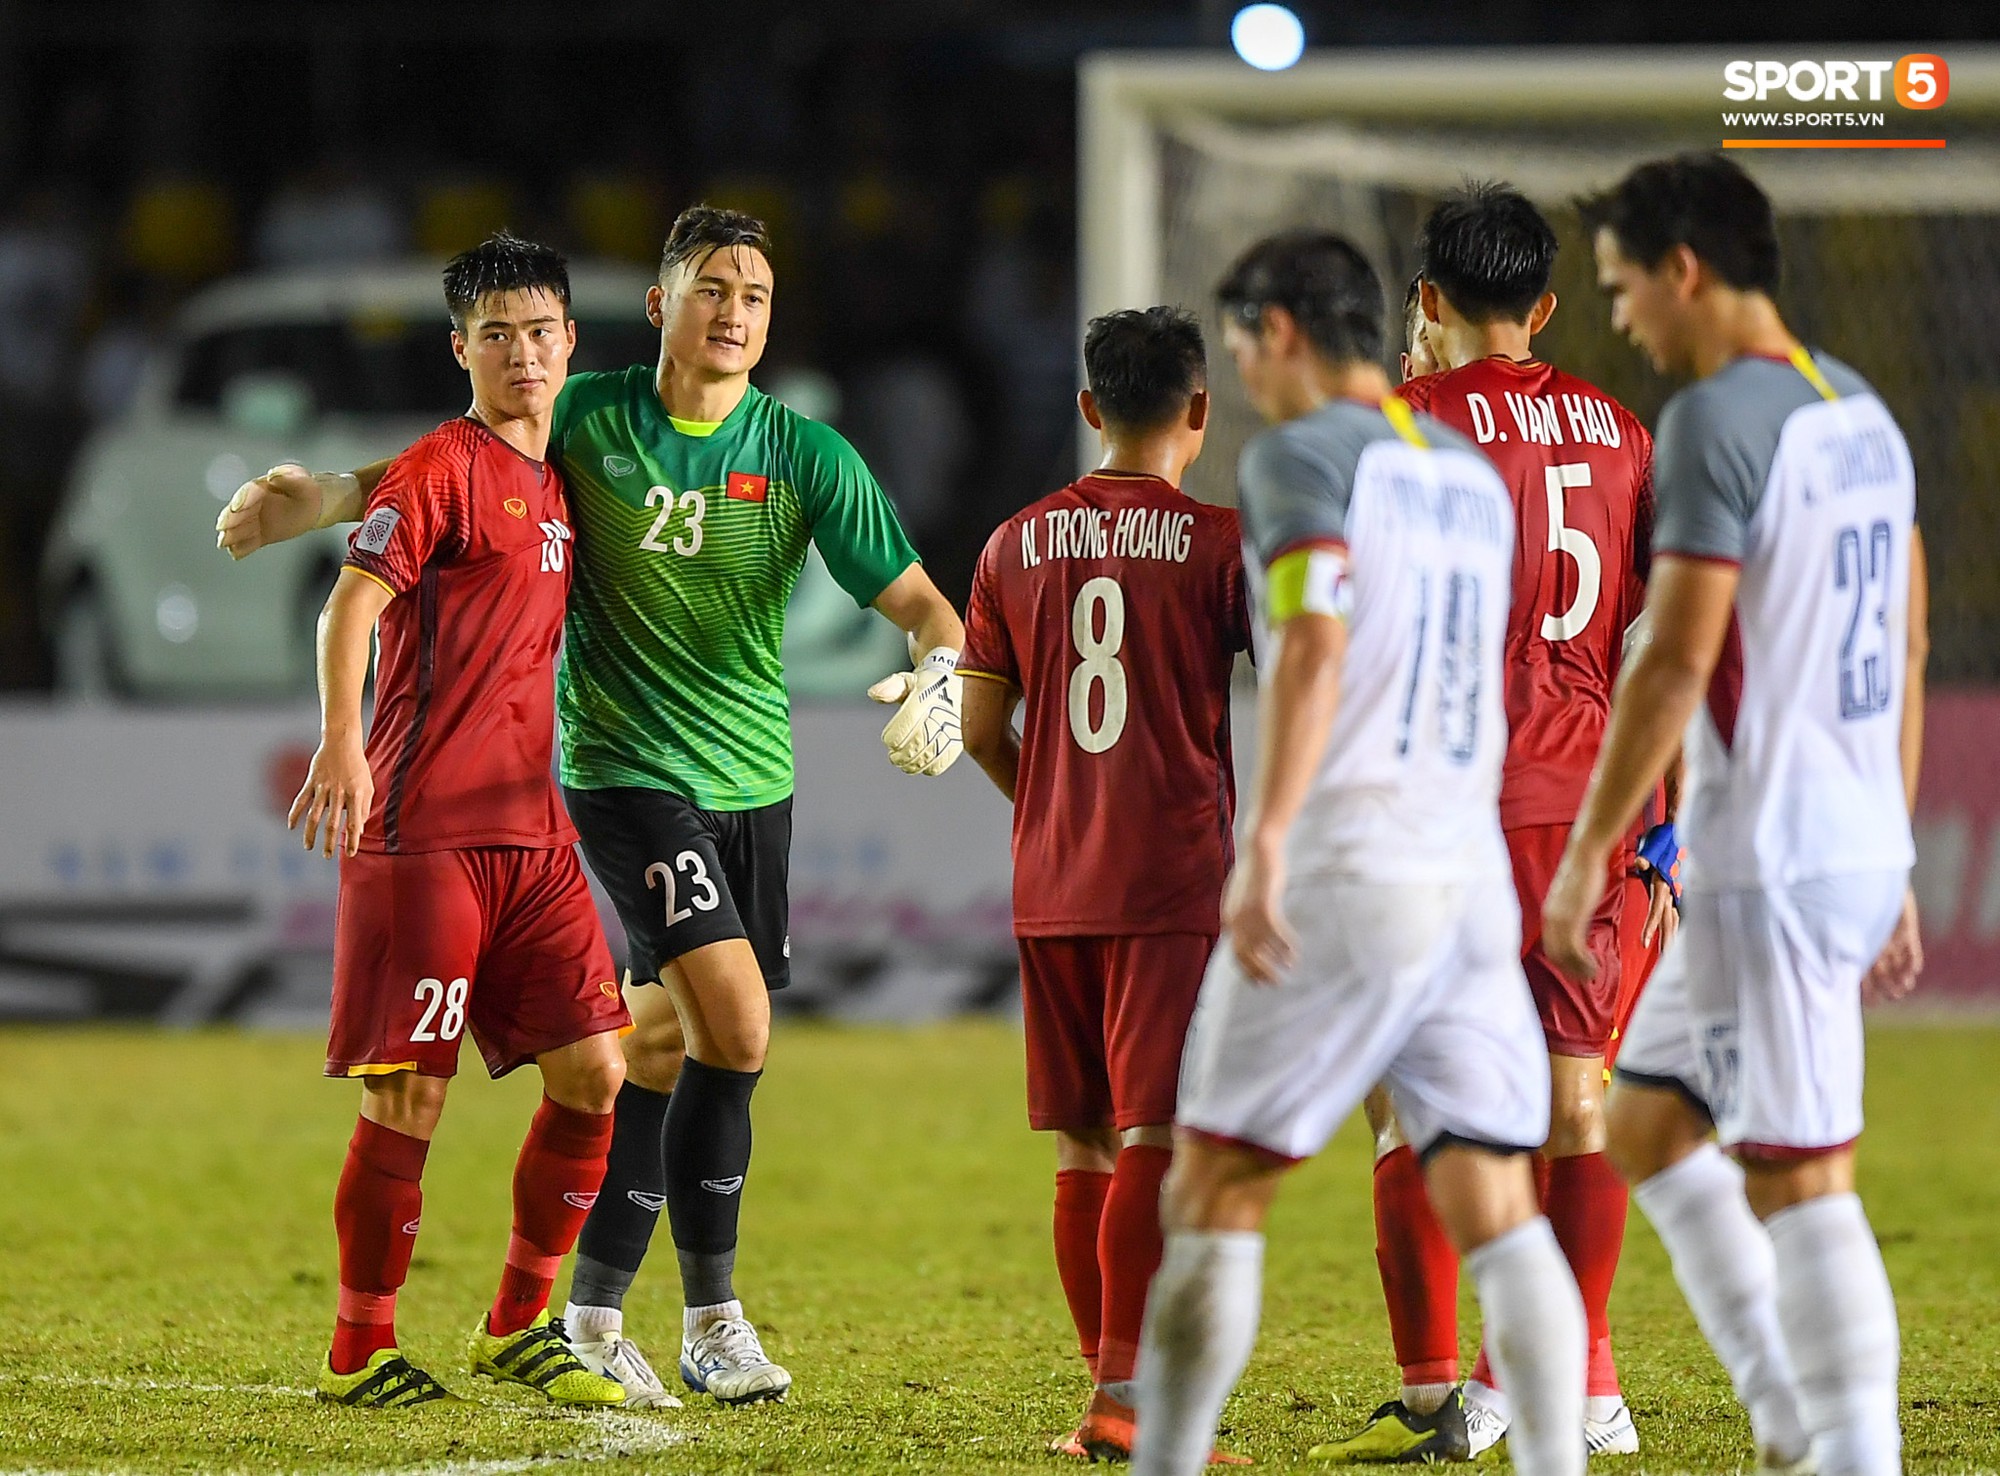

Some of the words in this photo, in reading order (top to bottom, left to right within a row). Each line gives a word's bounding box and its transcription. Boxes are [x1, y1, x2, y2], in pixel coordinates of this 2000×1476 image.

[1466, 392, 1508, 443] D.
[1504, 391, 1564, 446] VAN
[1561, 393, 1621, 449] HAU
[638, 484, 706, 557] 23
[1021, 517, 1041, 570] N.
[1045, 506, 1111, 560] TRONG
[1112, 507, 1195, 563] HOANG
[1540, 462, 1601, 641] 5
[1836, 521, 1891, 720] 23
[1069, 576, 1128, 754] 8
[644, 850, 720, 928] 23
[408, 977, 470, 1042] 28
